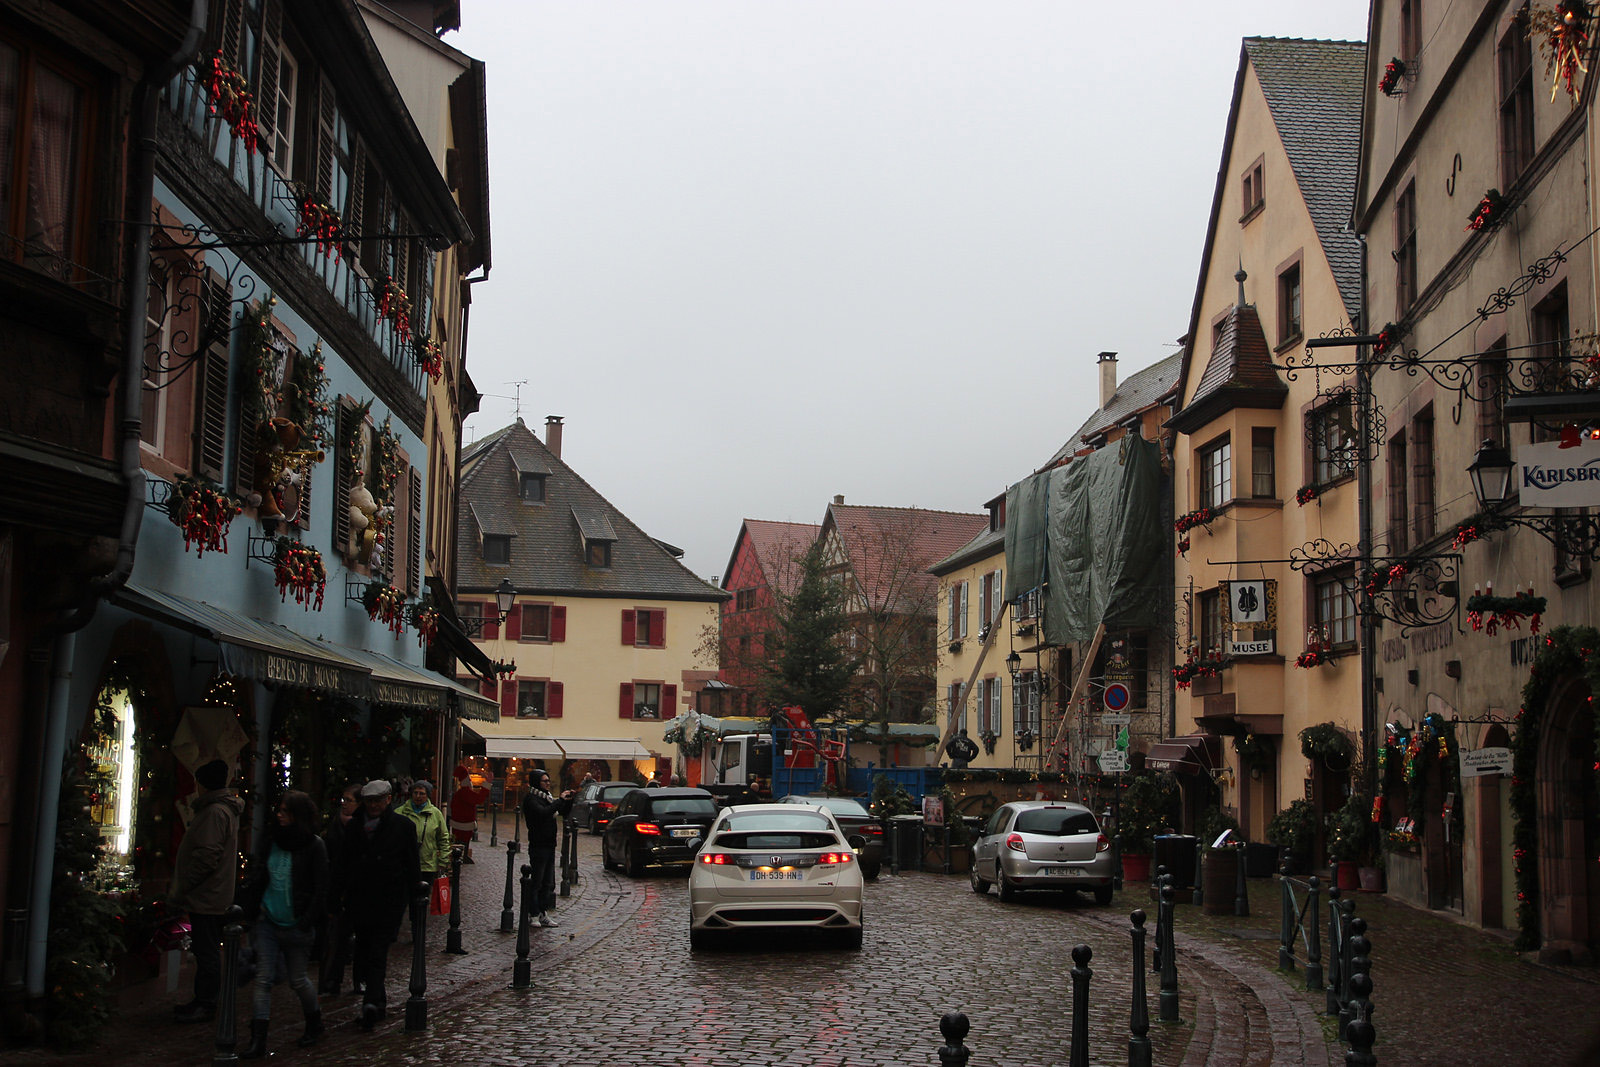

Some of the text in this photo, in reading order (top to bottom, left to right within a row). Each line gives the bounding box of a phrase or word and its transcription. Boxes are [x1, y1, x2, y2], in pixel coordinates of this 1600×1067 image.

[1523, 465, 1600, 490] KARLSBR
[1232, 643, 1269, 653] MUSEE
[267, 655, 297, 683] BIERES
